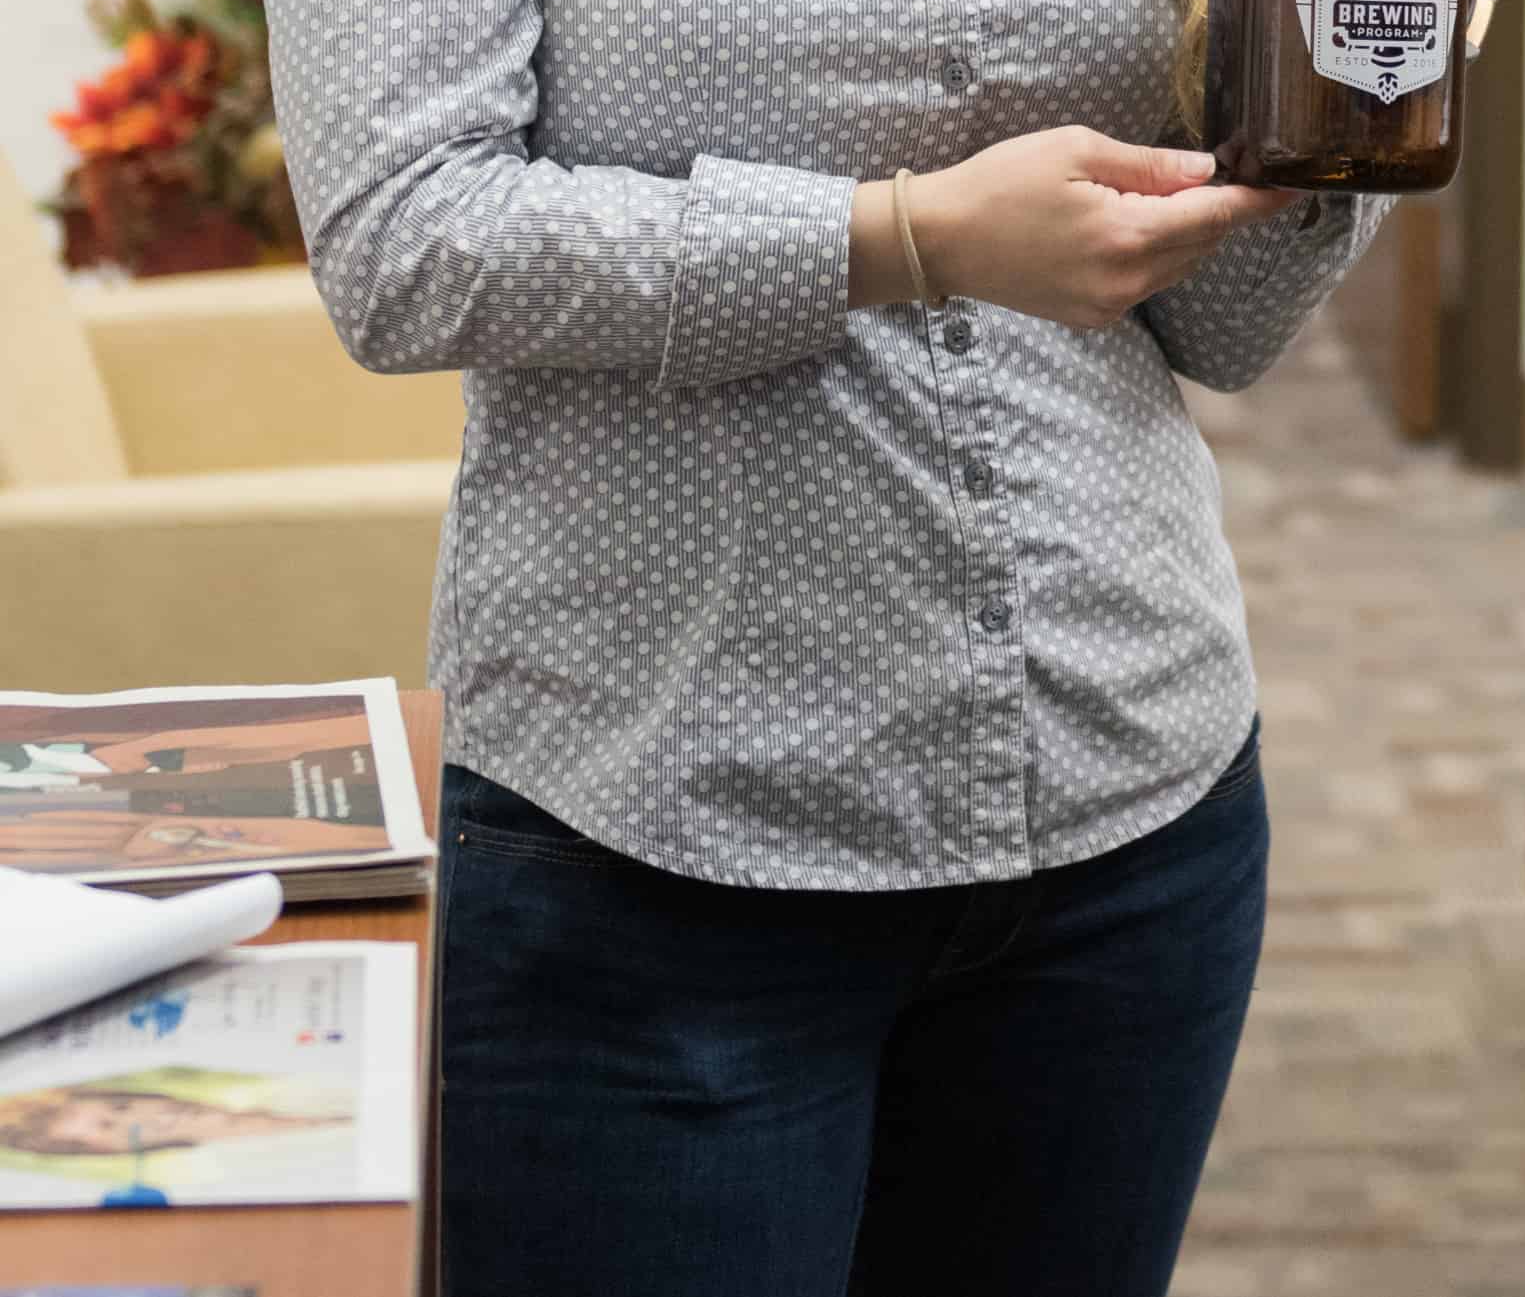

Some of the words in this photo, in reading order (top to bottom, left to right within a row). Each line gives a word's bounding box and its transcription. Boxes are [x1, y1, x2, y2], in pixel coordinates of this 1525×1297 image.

[1338, 3, 1433, 26] BREWING
[1357, 27, 1420, 39] PROGRAM
[1335, 56, 1369, 66] ESTD
